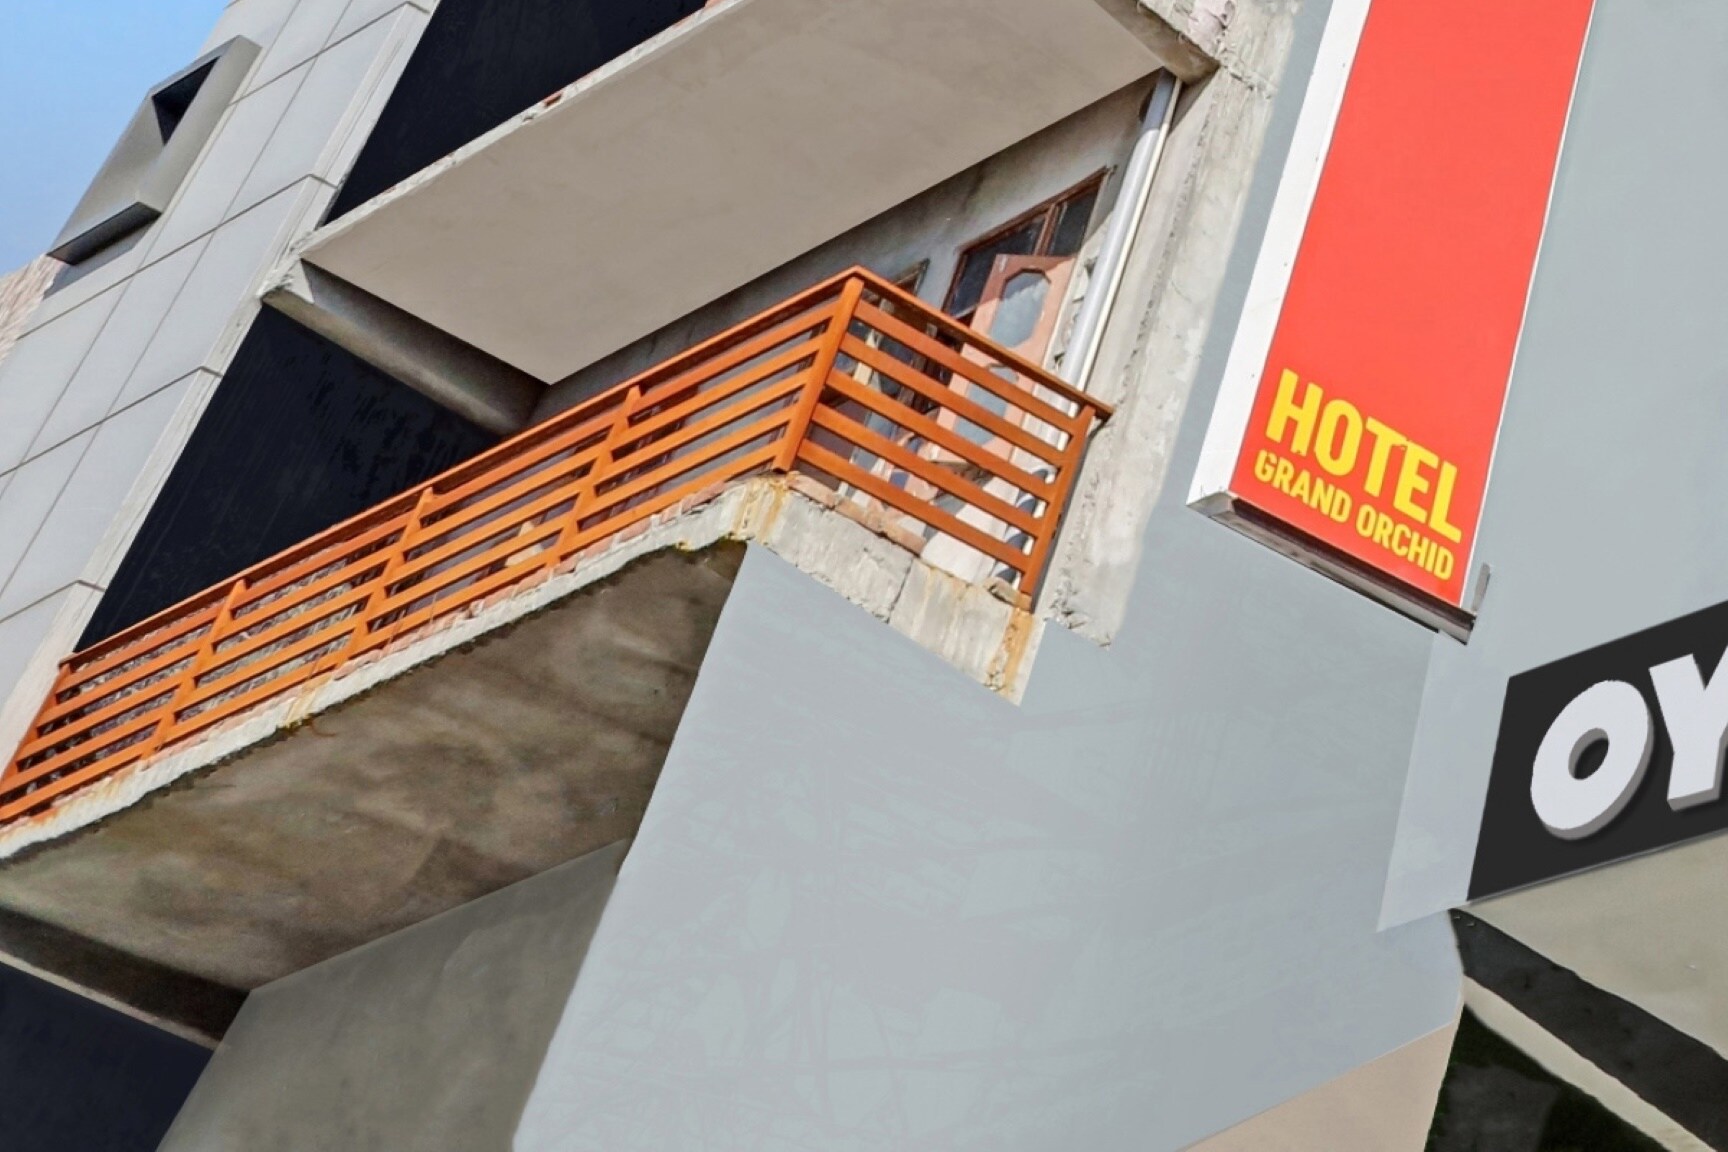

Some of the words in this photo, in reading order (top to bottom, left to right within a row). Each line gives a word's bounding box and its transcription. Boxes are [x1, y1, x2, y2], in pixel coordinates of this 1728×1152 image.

[1254, 449, 1352, 523] GRAND
[1356, 504, 1454, 580] ORCHID
[1265, 368, 1462, 543] HOTEL
